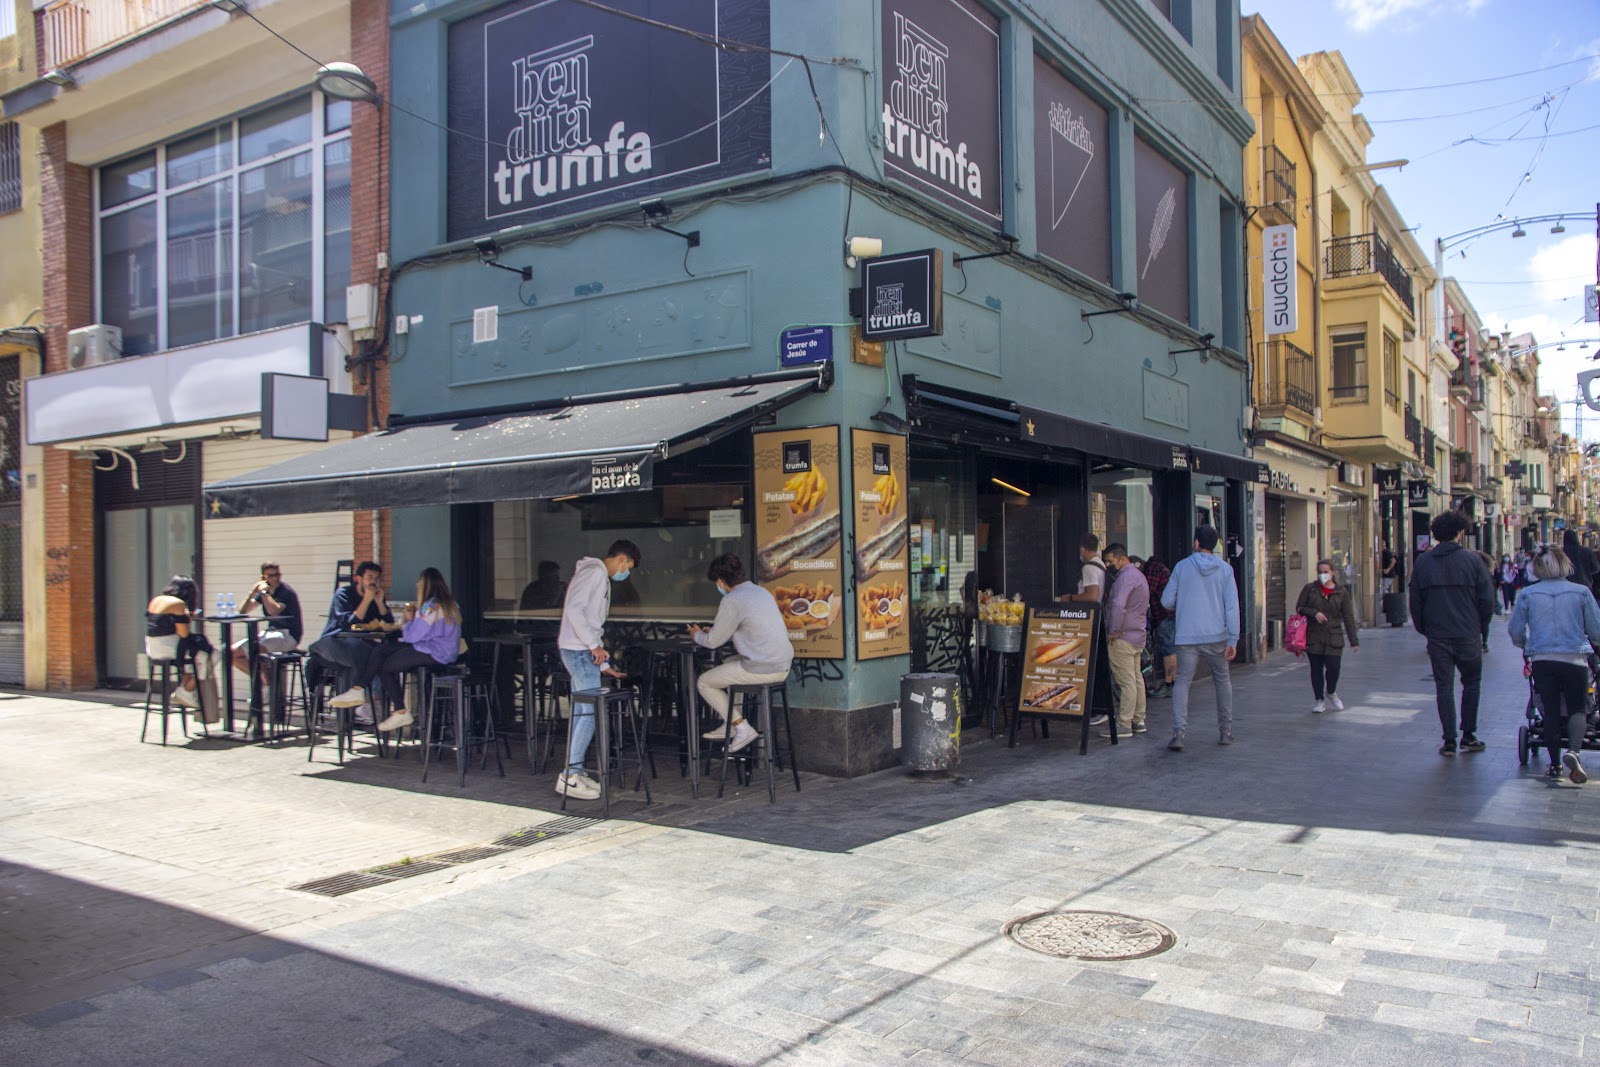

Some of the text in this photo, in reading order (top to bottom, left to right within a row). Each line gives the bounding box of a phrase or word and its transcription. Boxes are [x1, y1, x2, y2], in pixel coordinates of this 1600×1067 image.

[882, 103, 982, 199] trumfa
[494, 121, 652, 205] trumfa
[1270, 247, 1288, 326] swatch
[870, 309, 921, 329] trumfa
[787, 340, 818, 350] Carrer de
[787, 349, 806, 358] Jesús
[592, 466, 601, 474] En
[601, 465, 608, 473] el
[623, 463, 632, 472] de
[785, 461, 808, 470] trumfa
[592, 471, 641, 493] patata
[765, 492, 795, 501] Patatas
[793, 560, 834, 569] Bocadillos
[1060, 609, 1088, 618] Menús
